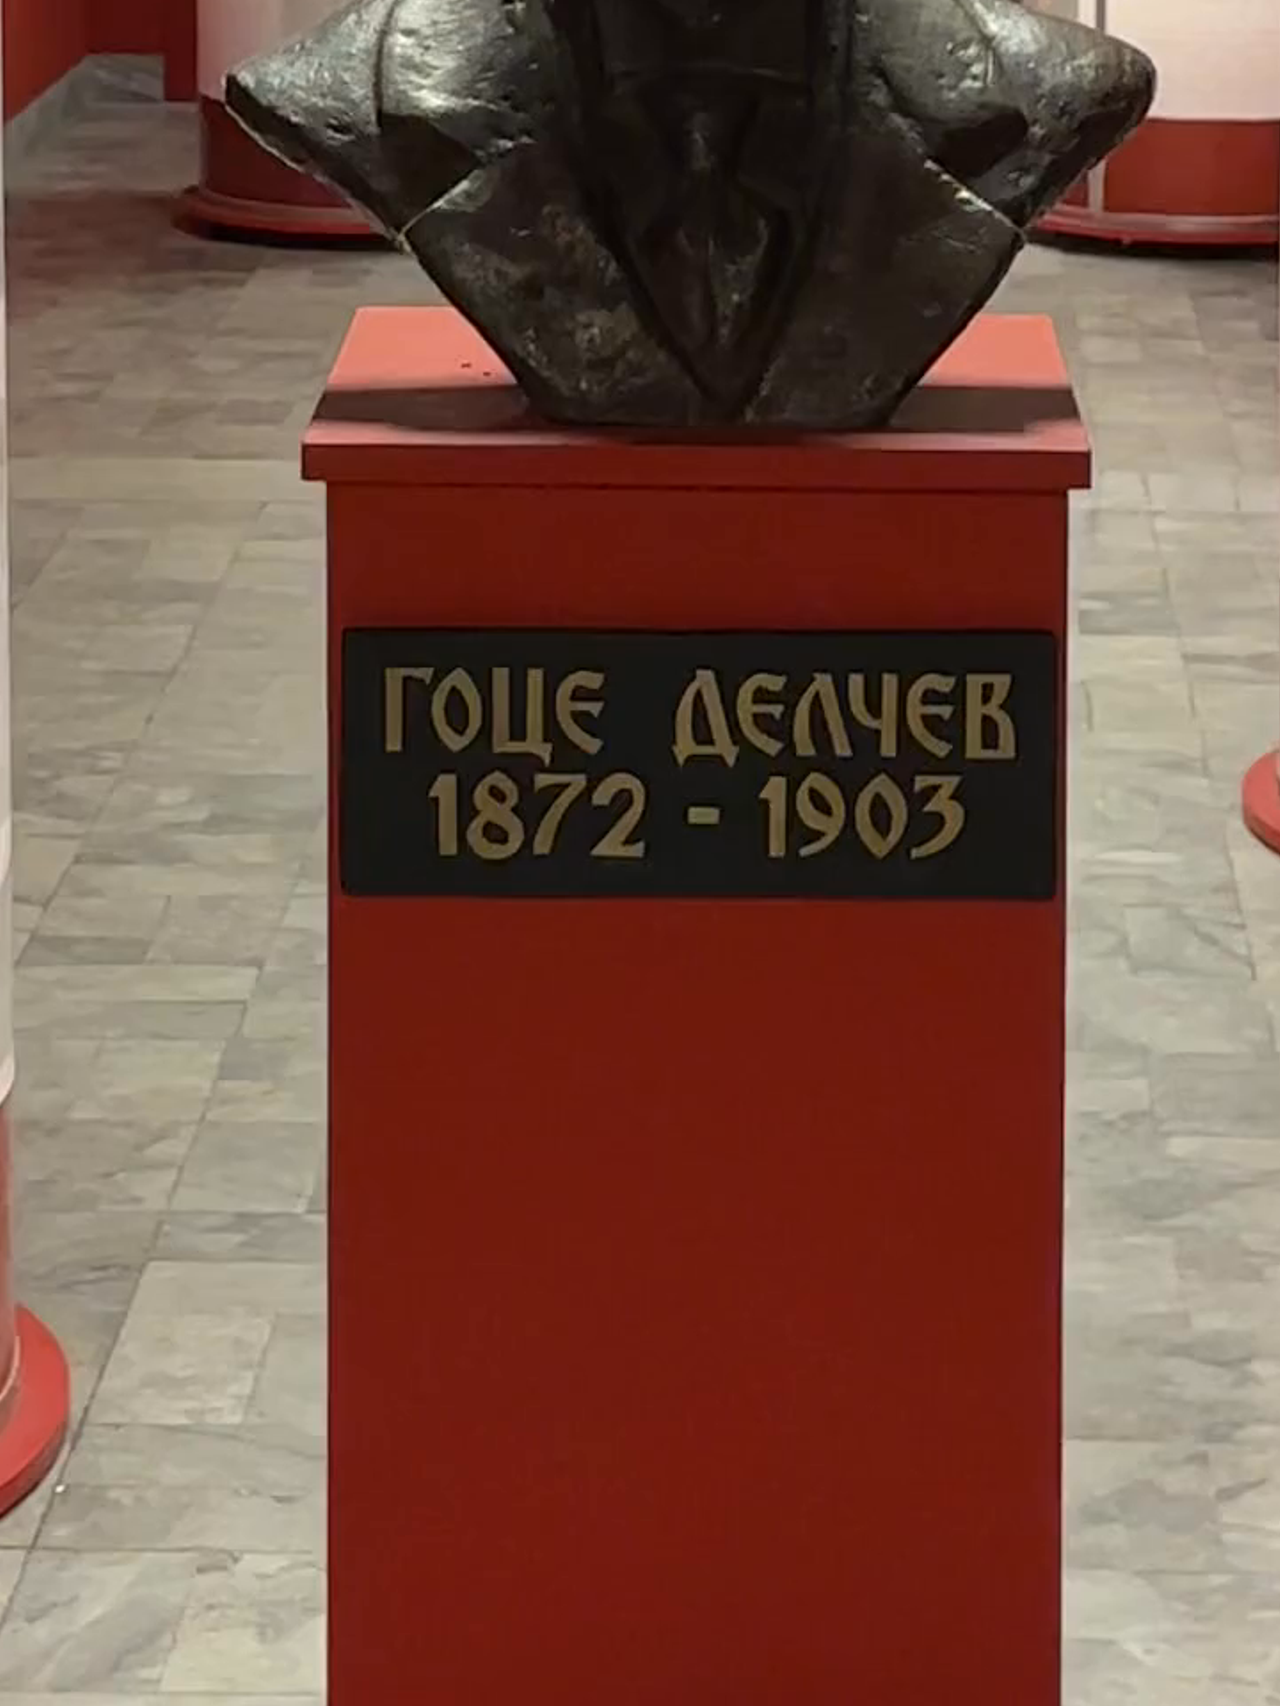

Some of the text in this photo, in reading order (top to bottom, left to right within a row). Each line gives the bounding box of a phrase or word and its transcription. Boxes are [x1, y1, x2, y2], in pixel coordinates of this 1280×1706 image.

[383, 666, 1017, 769] ГОЦЕ ДЕЛЧЕВ
[428, 769, 647, 861] 1872
[758, 771, 967, 862] 1903
